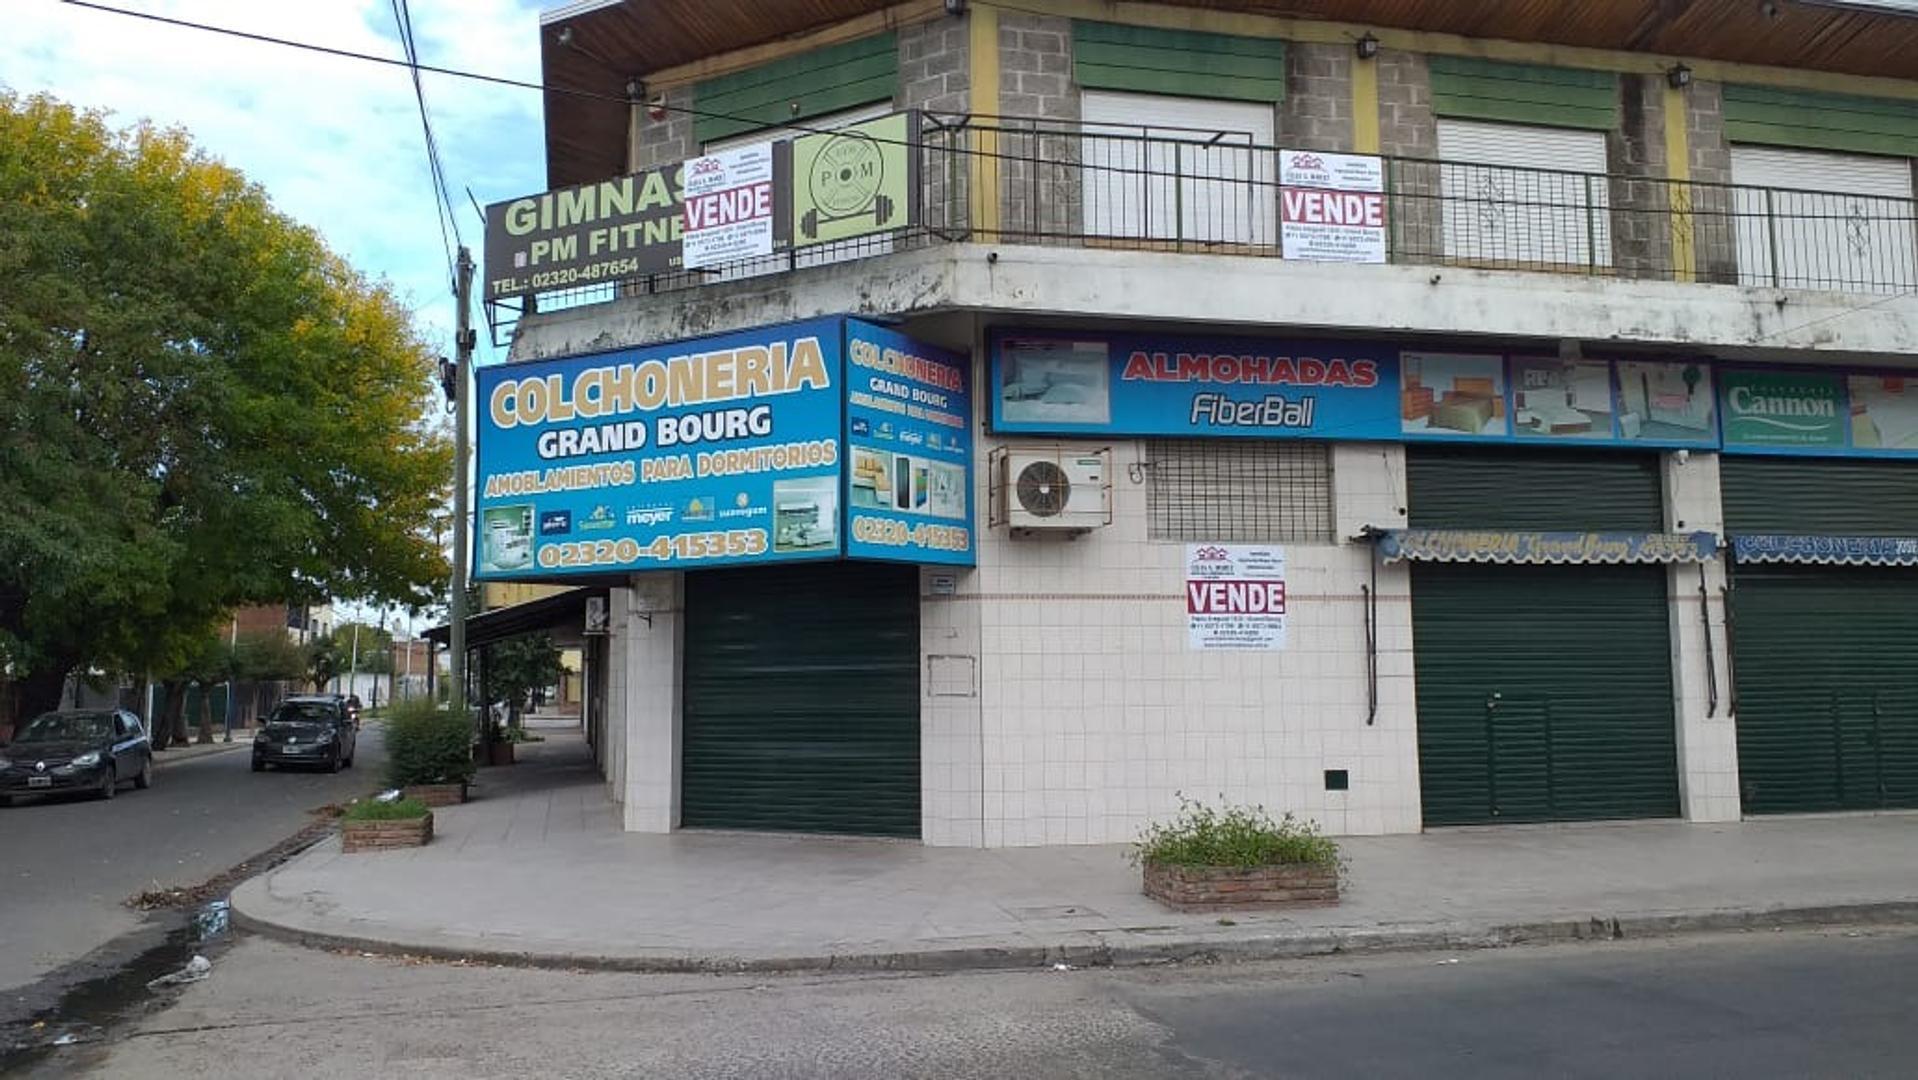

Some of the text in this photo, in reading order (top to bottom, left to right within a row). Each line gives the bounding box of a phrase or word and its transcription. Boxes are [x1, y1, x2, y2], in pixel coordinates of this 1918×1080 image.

[685, 184, 772, 230] VENDE
[1283, 191, 1383, 226] VENDE
[531, 234, 578, 266] PM
[492, 257, 639, 294] TEL.: 02320-487654
[490, 336, 830, 428] COLCHONERIA
[869, 377, 910, 399] GRAND
[1122, 351, 1379, 388] ALMOHADAS
[1190, 393, 1315, 428] FiberBall
[1728, 386, 1835, 417] Cannon
[538, 406, 772, 459] GRAND BOURG
[483, 439, 837, 498] AMOBLAMIENTOS PARA DORMITORIOS
[539, 528, 768, 568] 02320-415353
[1189, 583, 1284, 612] VENDE
